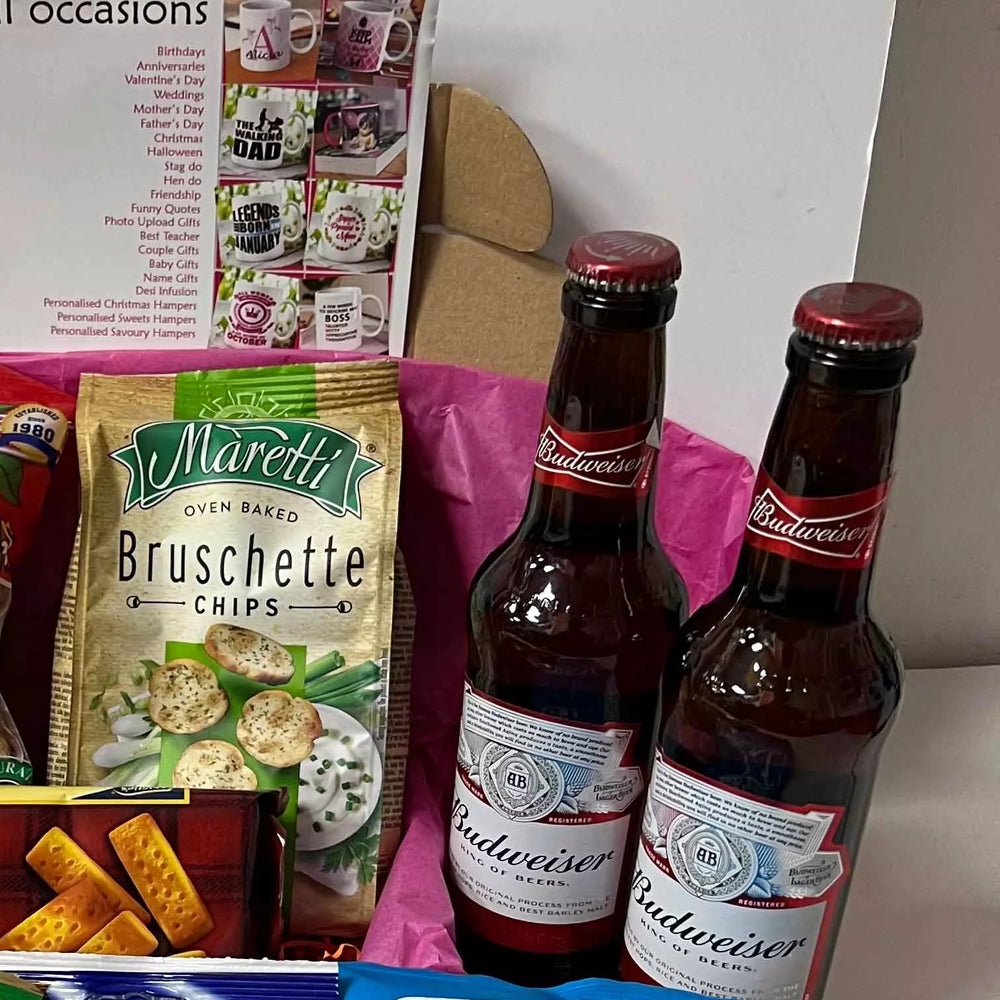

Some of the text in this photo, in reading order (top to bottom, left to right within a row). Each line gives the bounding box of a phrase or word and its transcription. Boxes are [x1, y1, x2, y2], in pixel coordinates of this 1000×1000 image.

[30, 0, 208, 25] occasions
[157, 46, 206, 58] Birthdays
[136, 61, 206, 72] Anniversaries
[124, 74, 205, 88] Valentine's Day
[153, 90, 205, 102] Weddings
[133, 104, 205, 116] Mother's Day
[140, 119, 205, 131] Father's Day
[235, 119, 255, 131] THE
[153, 133, 203, 143] Christmas
[235, 129, 283, 142] WALKING
[147, 147, 203, 157] Halloween
[233, 138, 282, 161] DAD
[164, 161, 202, 173] Stag do
[163, 176, 202, 186] Hen do
[150, 190, 202, 201] Friendship
[131, 203, 201, 215] Funny Quotes
[233, 203, 280, 222] LEGENDS
[104, 216, 201, 229] Photo Upload Gifts
[139, 231, 200, 242] Best Teacher
[235, 231, 281, 255] JANUARY
[138, 245, 200, 257] Couple Gifts
[149, 259, 199, 271] Baby Gifts
[143, 273, 199, 283] Name Gifts
[135, 286, 198, 296] Desi Infusion
[43, 297, 197, 312] Personalised Christmas Hampers
[57, 312, 197, 326] Personalised Sweets Hampers
[325, 313, 350, 323] BOSS
[50, 326, 196, 341] Personalised Savoury Hampers
[227, 332, 268, 346] OCTOBER
[12, 422, 56, 444] 1980
[148, 422, 343, 490] Maretti
[537, 434, 646, 474] Budweiser
[184, 501, 299, 524] OVEN BAKED
[752, 495, 872, 543] Budweiser
[118, 530, 365, 588] Bruschette
[195, 595, 279, 617] CHIPS
[451, 797, 615, 875] Budweiser
[460, 843, 485, 867] KING
[489, 865, 509, 877] OF
[496, 900, 517, 910] AND
[519, 906, 544, 916] BEST
[518, 897, 563, 909] PROCESS
[631, 868, 808, 959] Budweiser
[640, 917, 690, 956] KING OF
[655, 957, 748, 995] ORIGINAL PROCESS
[676, 979, 698, 993] AND
